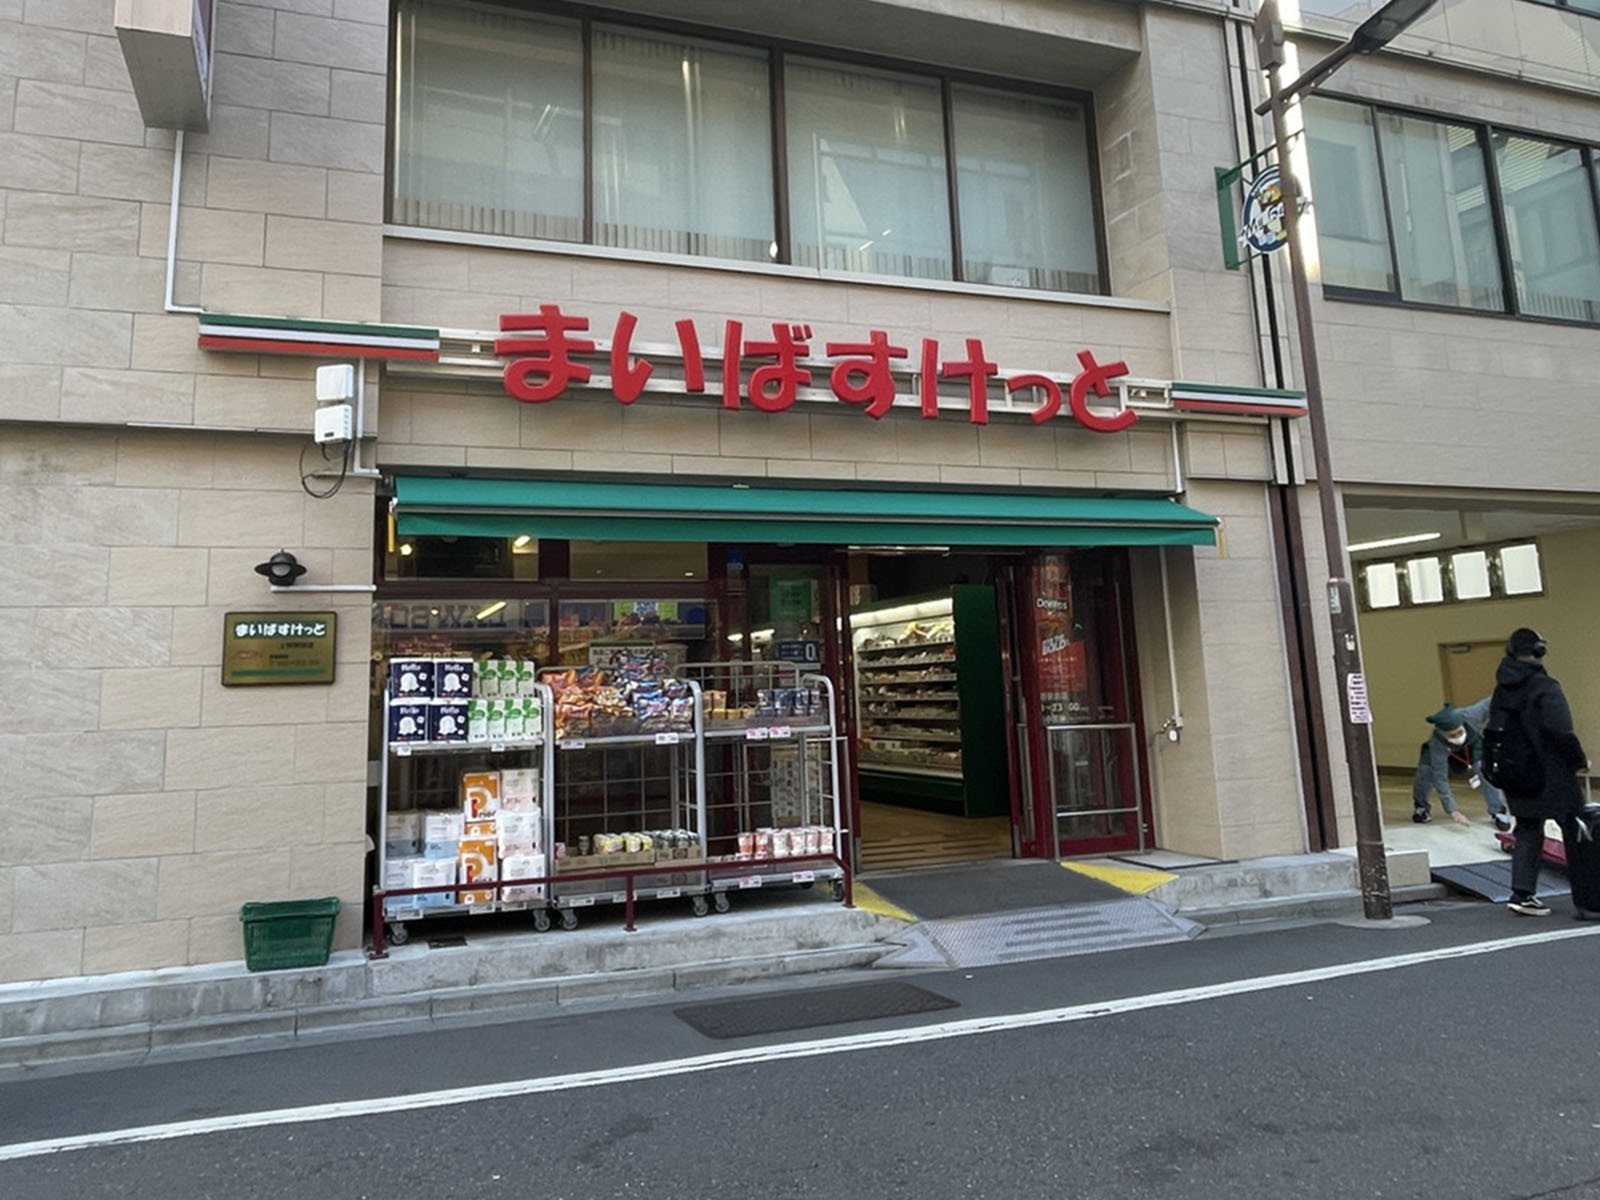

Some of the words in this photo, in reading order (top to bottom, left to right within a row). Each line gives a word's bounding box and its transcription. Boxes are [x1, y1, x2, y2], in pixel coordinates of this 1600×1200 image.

[495, 305, 1137, 432] まいばすけっと
[235, 623, 326, 638] まいばすけっと
